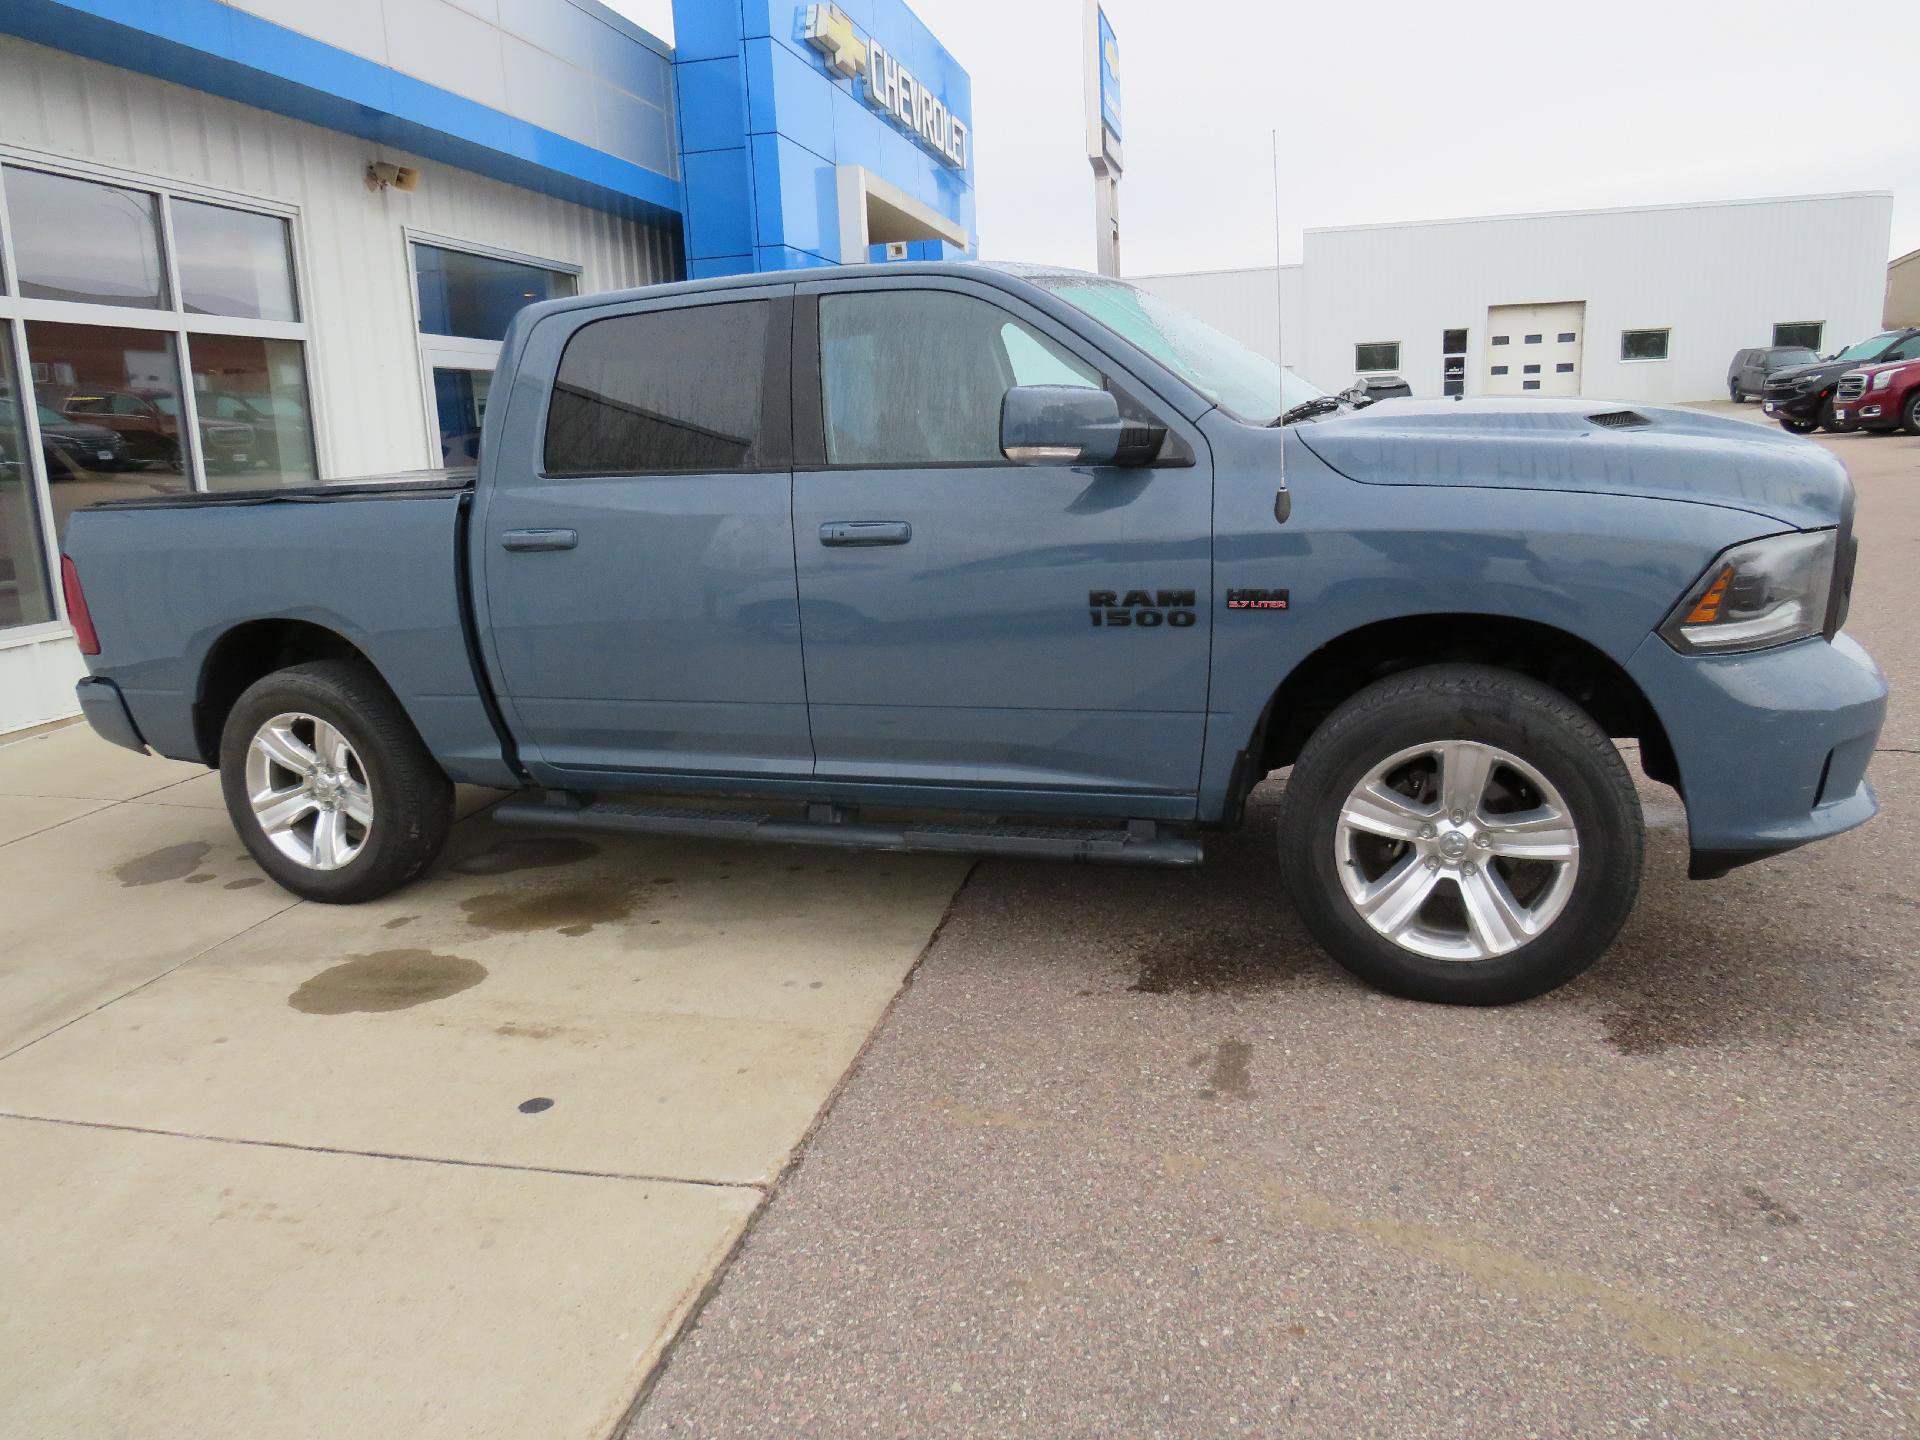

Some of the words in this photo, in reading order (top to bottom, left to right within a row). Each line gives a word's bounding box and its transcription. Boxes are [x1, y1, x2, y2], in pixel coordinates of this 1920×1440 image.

[868, 37, 967, 170] CHEVROLET
[1089, 590, 1195, 607] RAM
[1228, 600, 1249, 608] 5.7
[1250, 600, 1287, 608] LITER
[1090, 610, 1195, 626] 1500
